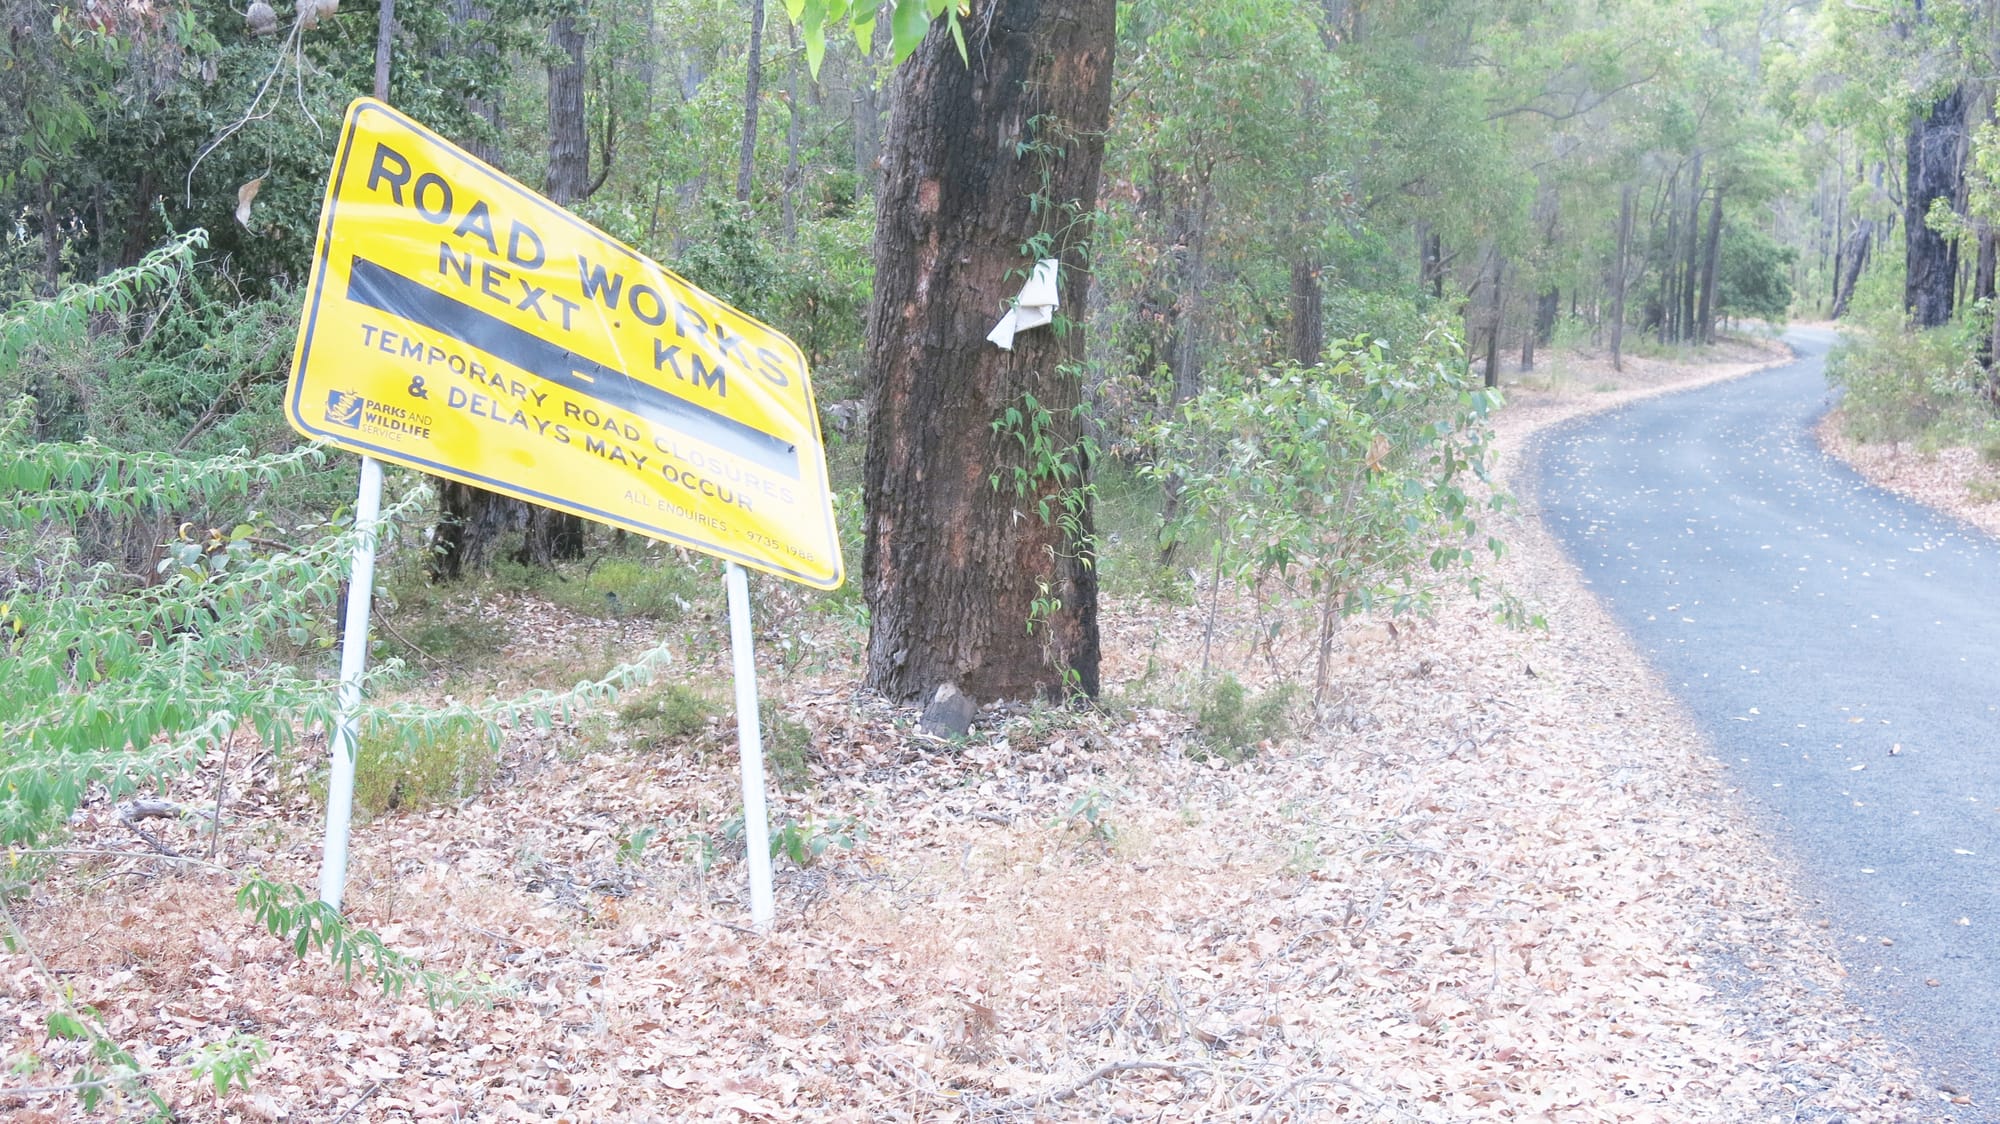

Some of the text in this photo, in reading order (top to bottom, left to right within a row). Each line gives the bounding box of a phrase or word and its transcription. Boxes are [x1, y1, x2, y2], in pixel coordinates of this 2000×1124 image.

[367, 142, 788, 387] ROAD WORKS
[439, 241, 726, 398] NEXT KM
[361, 324, 794, 504] TEMPORARY ROAD CLOSURES
[362, 423, 401, 442] SERVICE
[365, 412, 430, 439] WILDLIFE
[366, 399, 432, 426] PARKS AND
[408, 375, 753, 513] & DELAYS MAY OCCUR
[625, 490, 649, 506] ALL
[658, 499, 727, 532] ENQUIRIES
[746, 530, 780, 550] 9735
